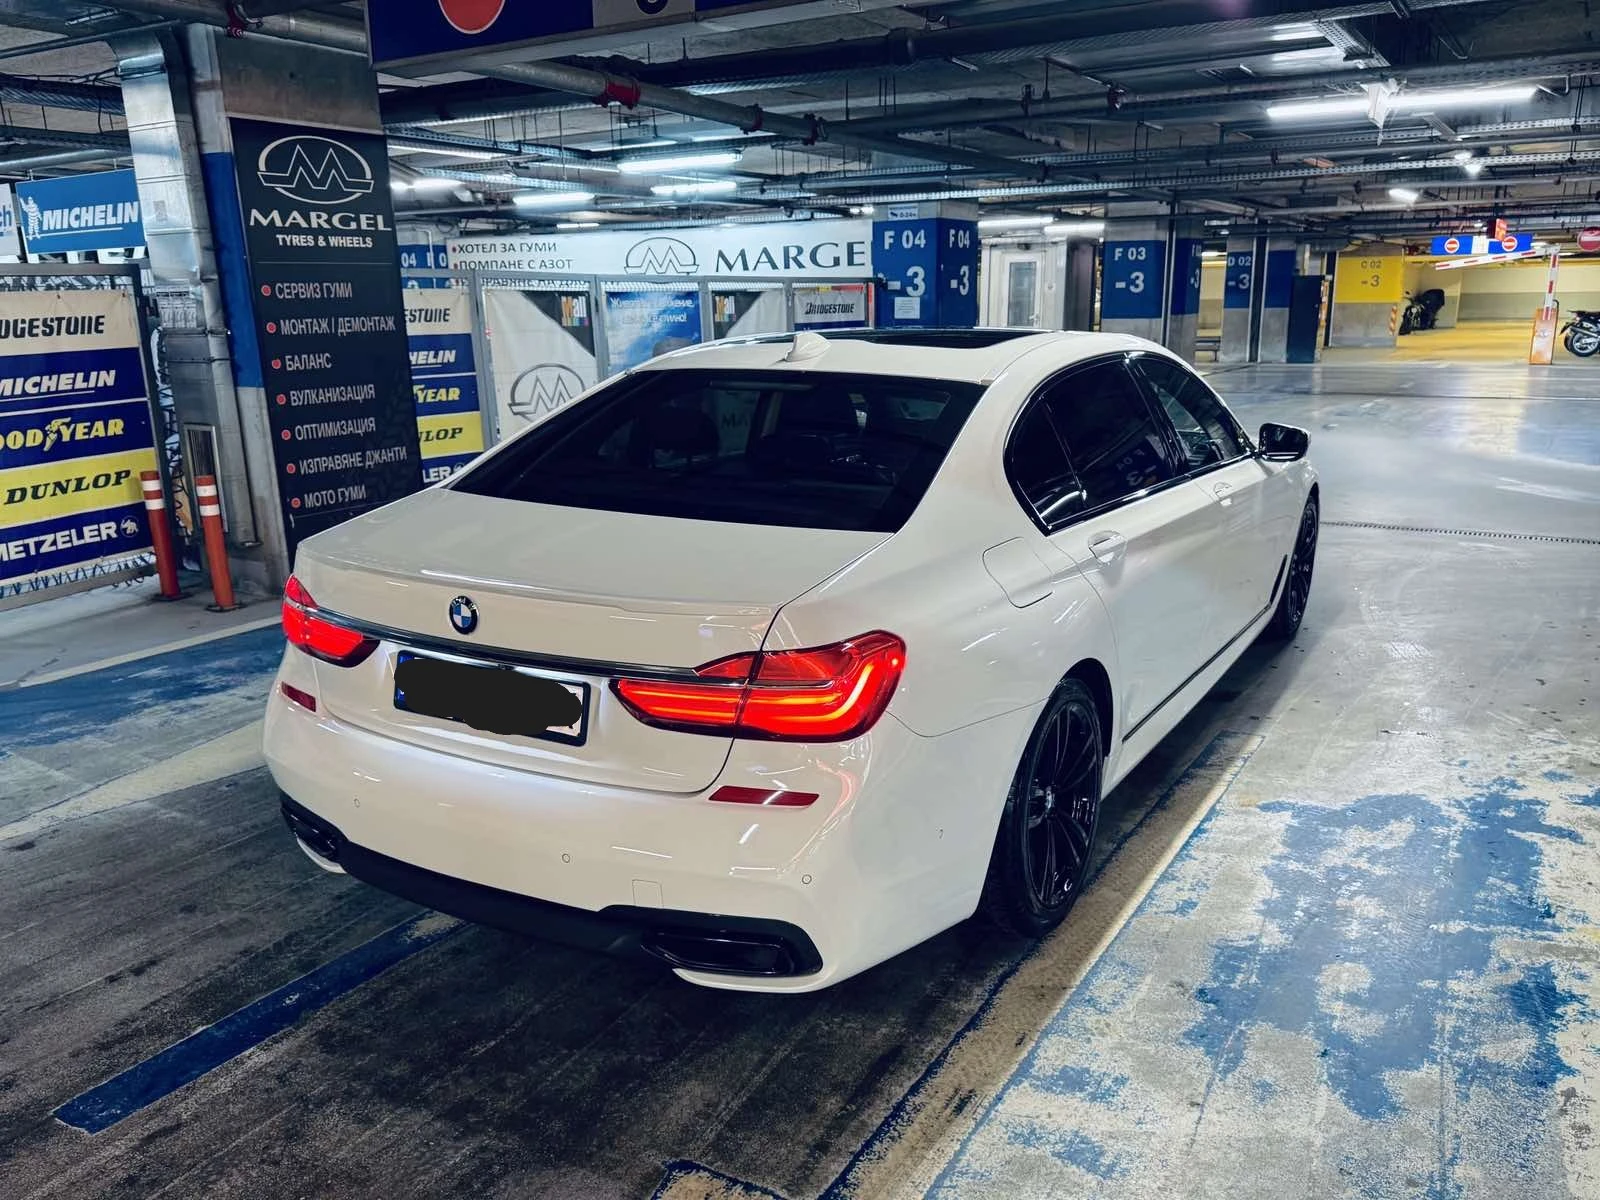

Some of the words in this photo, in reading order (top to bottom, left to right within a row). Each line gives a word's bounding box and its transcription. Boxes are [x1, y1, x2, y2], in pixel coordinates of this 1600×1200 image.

[42, 201, 139, 231] MICHELIN
[249, 208, 392, 231] MARGEL
[276, 234, 314, 247] TYRES
[318, 235, 327, 247] &
[328, 235, 373, 248] WHEELS
[458, 243, 497, 254] ХОТЕЛ
[500, 243, 516, 254] ЗА
[519, 242, 557, 253] ГУМИ
[884, 230, 895, 250] F
[901, 229, 926, 249] 04
[949, 229, 956, 248] F
[957, 230, 970, 249] 04
[401, 252, 417, 268] 04
[715, 241, 866, 273] MARGE
[1114, 248, 1124, 261] F
[1127, 247, 1146, 261] 03
[1238, 256, 1251, 266] 02
[459, 259, 524, 271] ПОМПАНЕ
[528, 259, 536, 270] С
[538, 259, 573, 270] АЗОТ
[275, 283, 321, 299] СЕРВИЗ
[323, 282, 353, 298] ГУМИ
[280, 317, 330, 336] МОНТАЖ
[337, 316, 396, 336] ДЕМОНТАЖ
[285, 353, 332, 371] БАЛАНС
[290, 384, 376, 406] ВУЛКАНИЗАЦИЯ
[294, 417, 376, 441] ОПТИМИЗАЦИЯ
[299, 452, 364, 475] ИЗПРАВЯНЕ
[365, 446, 407, 469] ДЖАНТИ
[4, 469, 131, 505] DUNLOP
[304, 489, 336, 508] МОТО
[337, 484, 367, 502] ГУМИ
